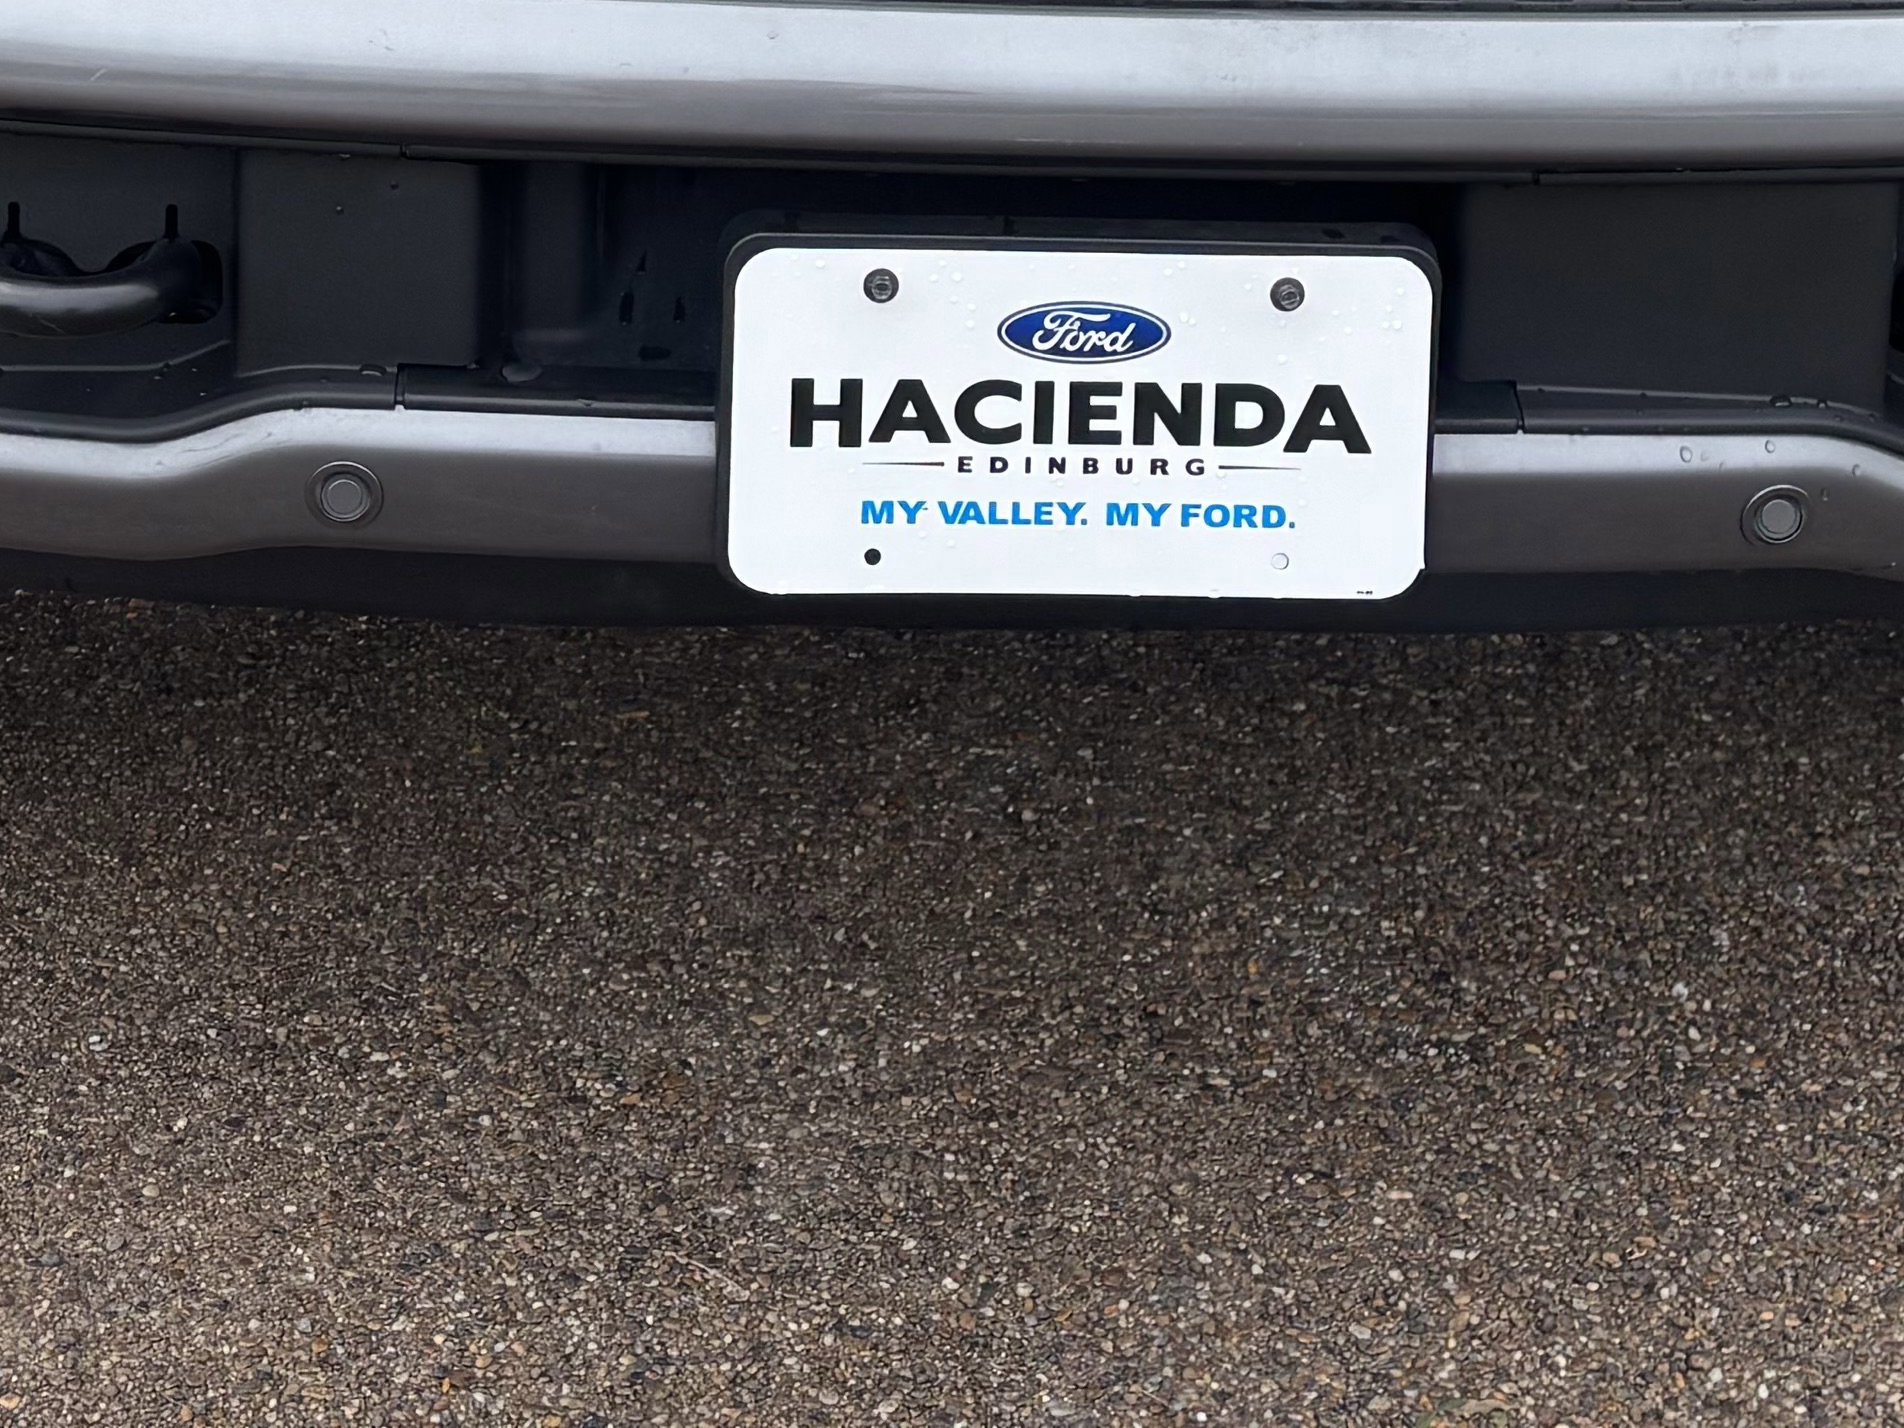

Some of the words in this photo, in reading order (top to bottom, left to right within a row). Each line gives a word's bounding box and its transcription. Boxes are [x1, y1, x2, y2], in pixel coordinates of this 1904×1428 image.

[1032, 309, 1135, 354] Ford
[789, 378, 1373, 455] HACIENDA
[958, 455, 1207, 477] EDINBURG
[860, 500, 928, 526] MY
[937, 502, 1089, 527] VALLEY.
[1105, 502, 1173, 528] MY
[1181, 503, 1296, 530] FORD.
